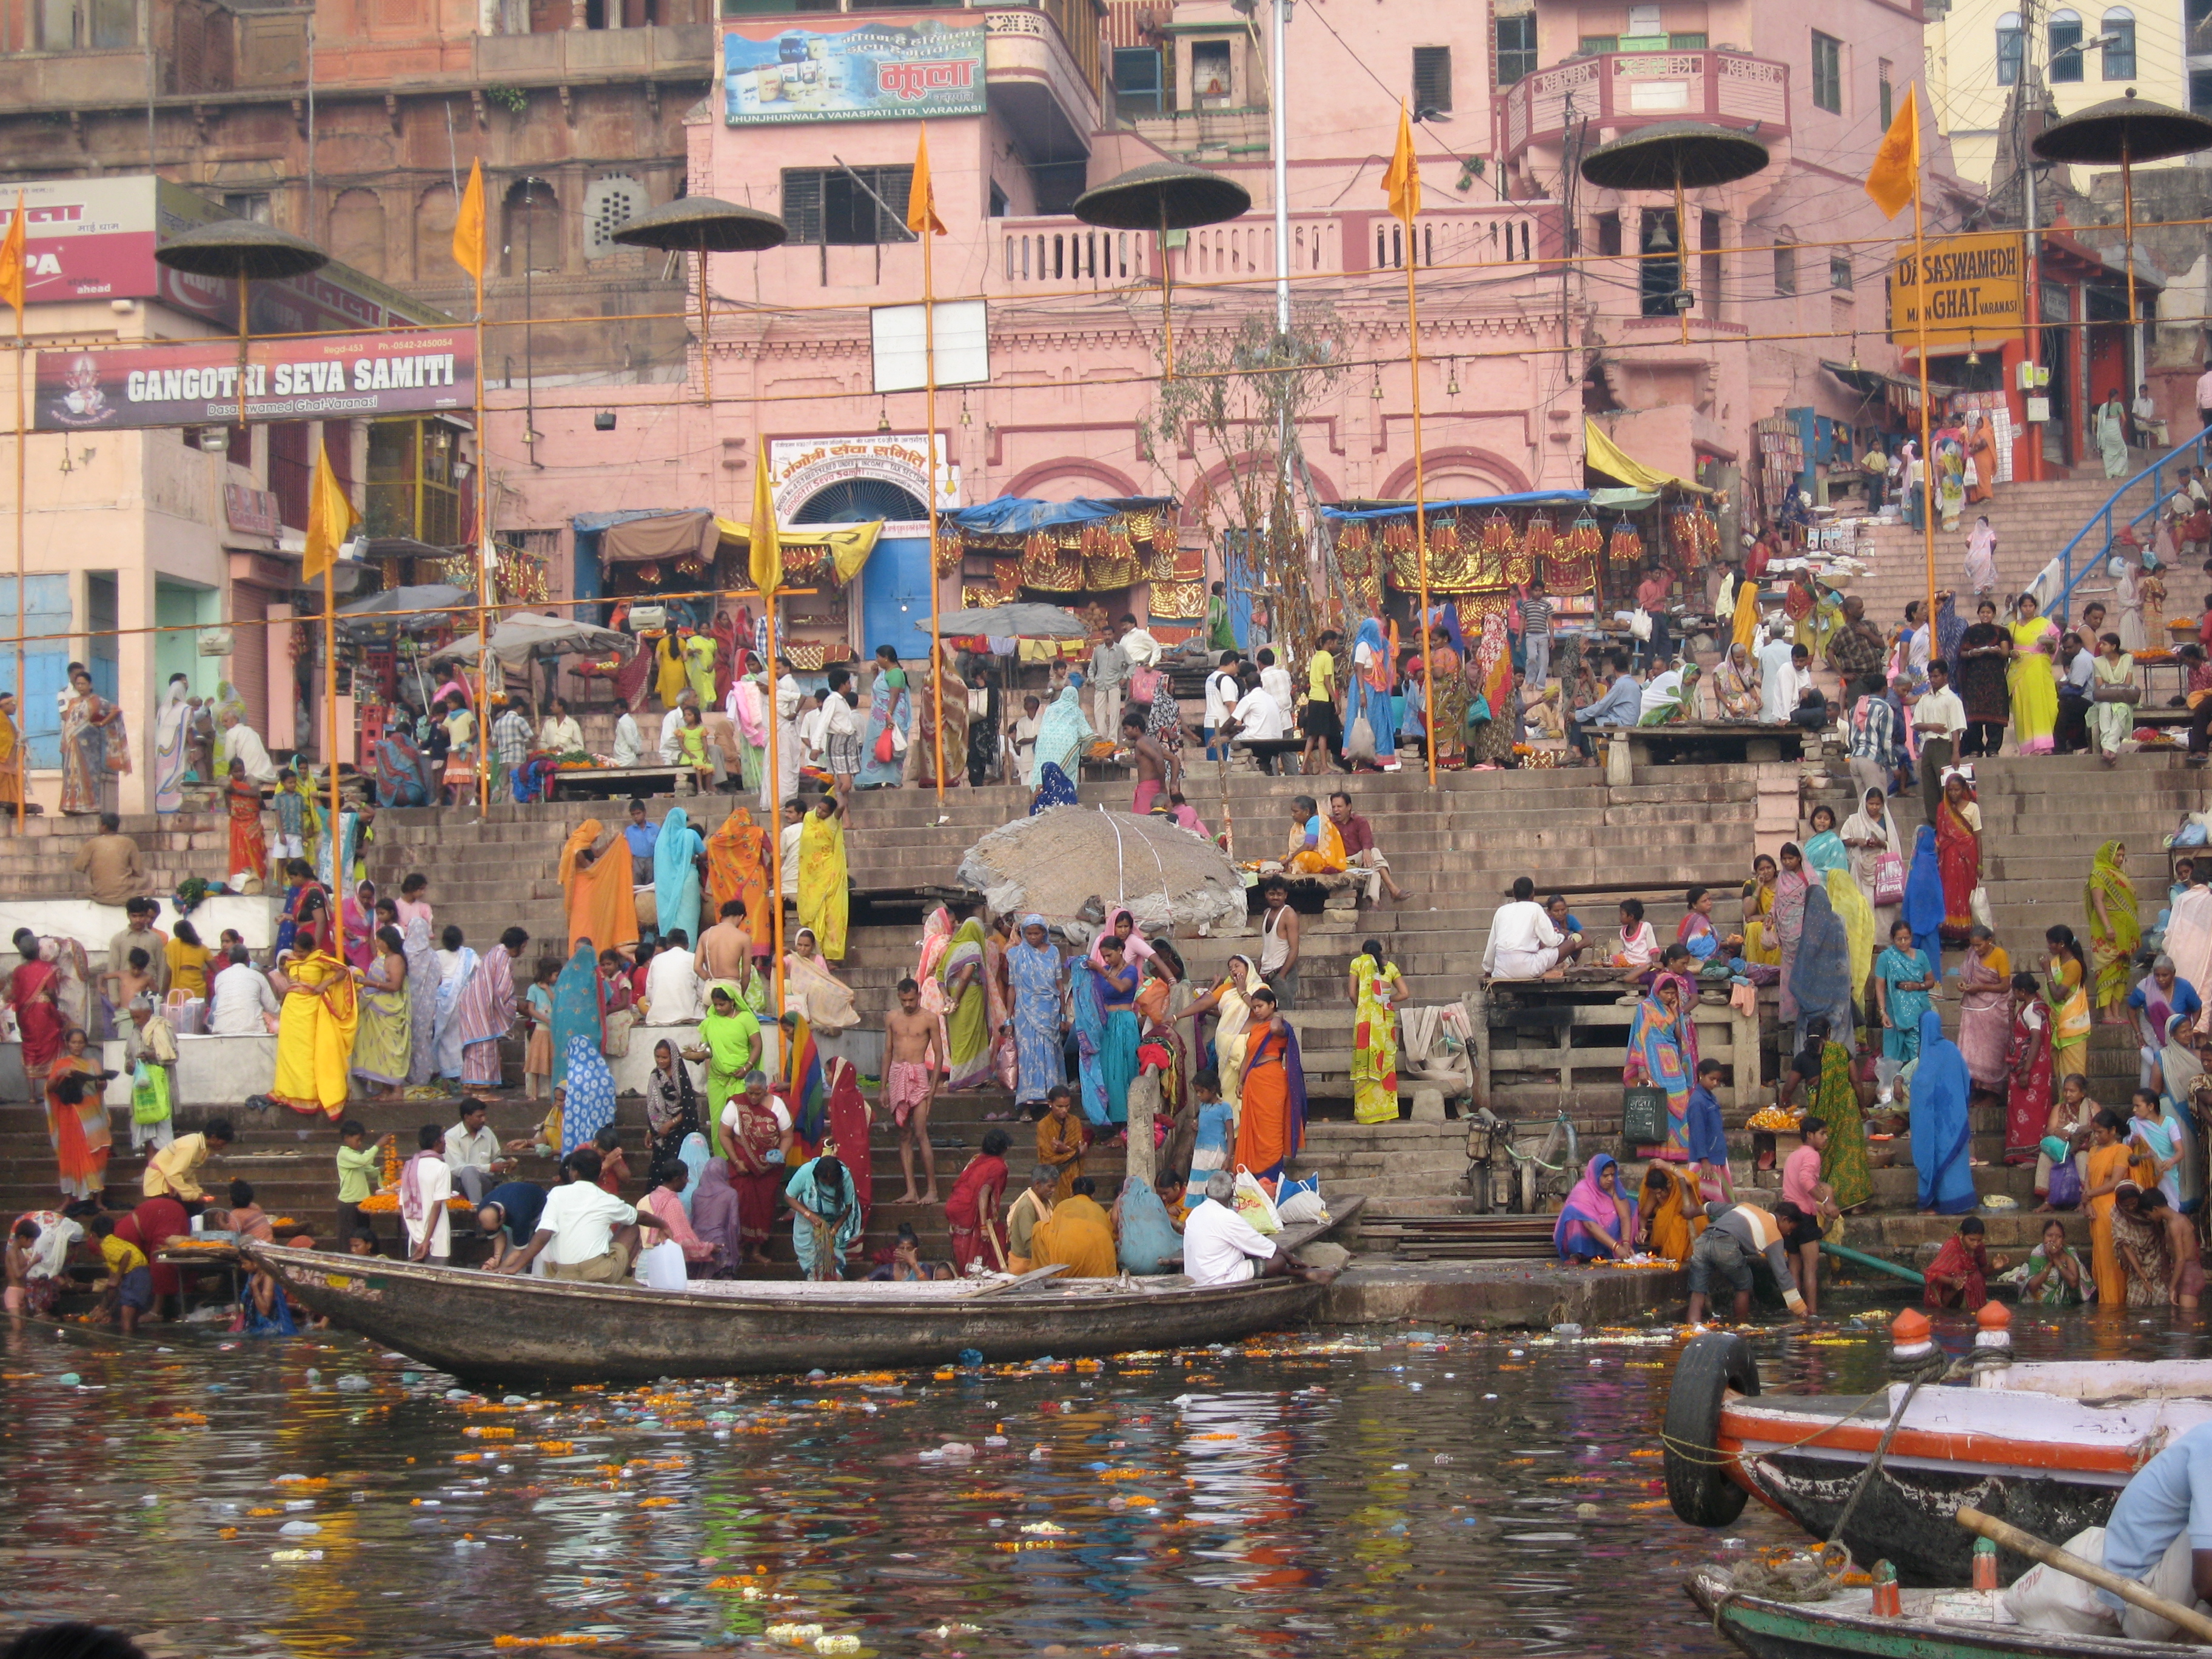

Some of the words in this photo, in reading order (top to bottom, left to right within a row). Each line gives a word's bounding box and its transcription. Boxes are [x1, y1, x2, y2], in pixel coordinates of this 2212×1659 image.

[879, 58, 980, 100] झूला
[729, 111, 825, 123] JHUNJHUNWALA
[828, 109, 891, 119] VANASPATI
[922, 105, 982, 114] VARANASI
[1899, 247, 2017, 287] DASASWAMEDH
[77, 283, 112, 294] ahead
[1932, 287, 1980, 320] GHAT
[1980, 300, 2017, 315] VARANASI
[324, 344, 364, 355] Regd-453
[378, 338, 453, 350] Ph.-0542-2450054
[128, 363, 266, 402] GANGOTRI
[275, 361, 346, 395] SEVA
[354, 354, 454, 391] SAMITI
[830, 444, 868, 456] सेवा
[873, 444, 927, 468] समिति
[813, 475, 834, 488] Seva
[838, 460, 854, 469] UNDER
[861, 460, 884, 469] INCOME
[890, 463, 901, 473] TAX
[902, 468, 927, 486] SECTION
